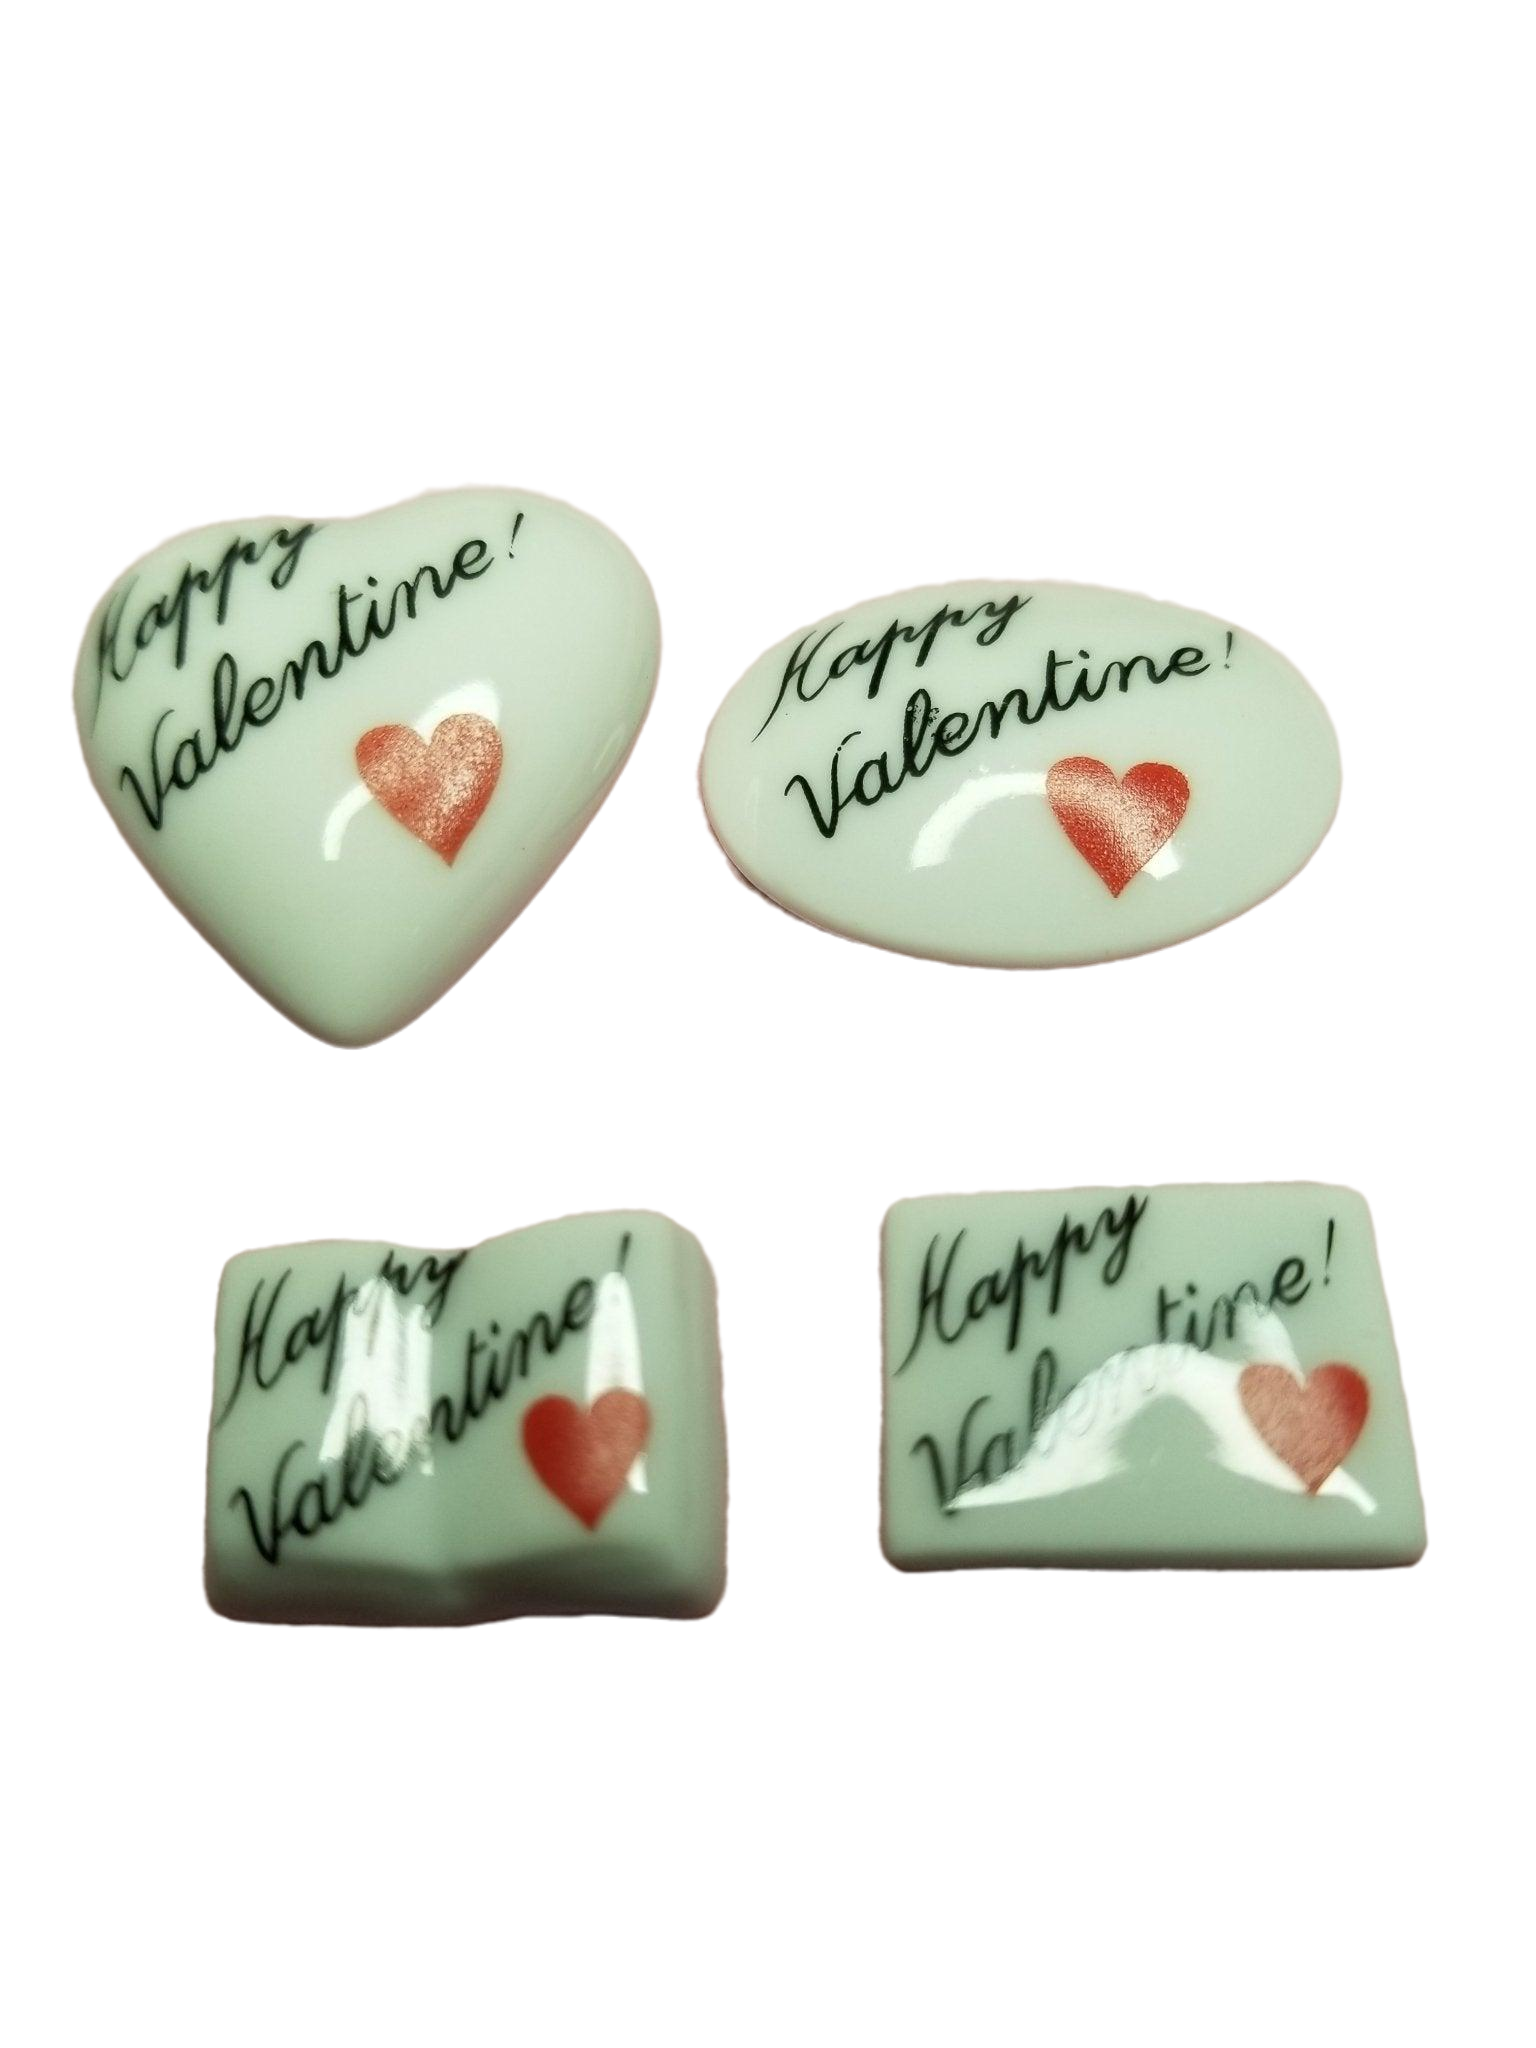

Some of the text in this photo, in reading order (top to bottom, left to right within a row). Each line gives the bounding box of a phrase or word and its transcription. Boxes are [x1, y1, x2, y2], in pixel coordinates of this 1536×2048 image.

[91, 523, 324, 739] Happy
[119, 513, 525, 831] Valentine!
[752, 594, 1034, 743] Happy
[785, 631, 1234, 838] Valentine!
[215, 1249, 470, 1428] Happy
[893, 1193, 1149, 1377] Happy
[909, 1218, 1335, 1516] Valtine!
